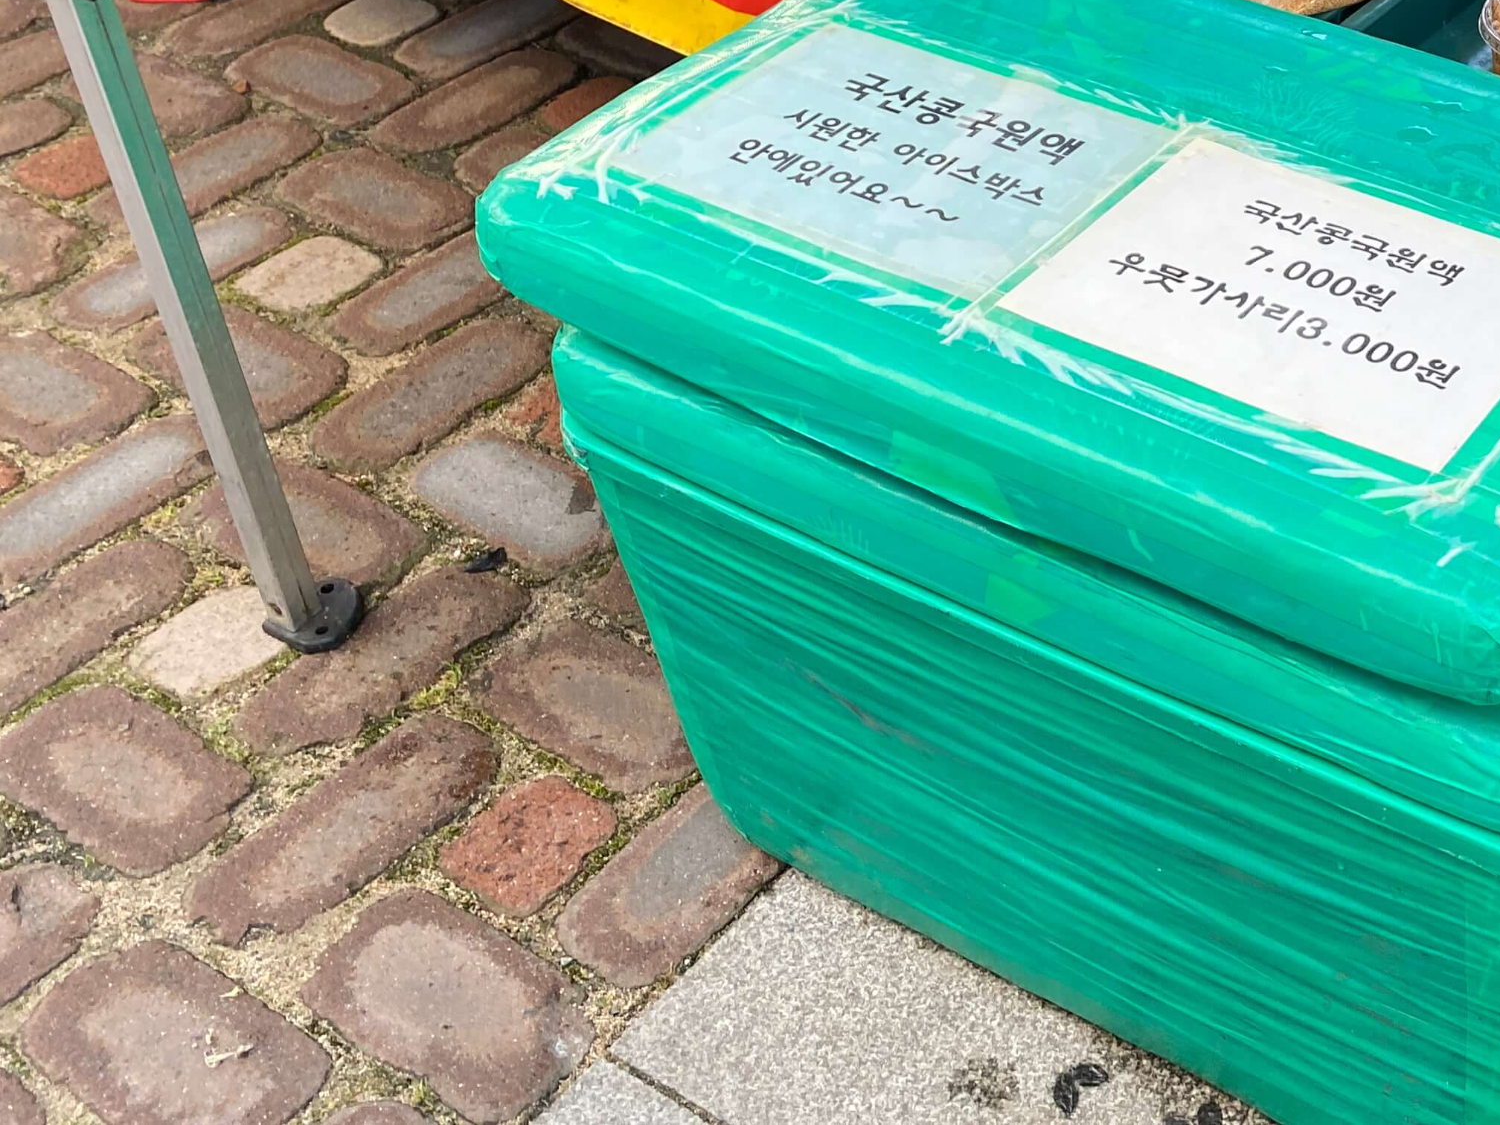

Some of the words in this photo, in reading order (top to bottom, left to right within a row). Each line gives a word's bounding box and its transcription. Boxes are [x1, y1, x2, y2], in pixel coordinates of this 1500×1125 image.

[783, 109, 881, 152] 시원한
[893, 143, 1047, 206] 아이스박스
[844, 73, 1085, 165] 국산콩국원액
[1244, 199, 1465, 287] 국산콩국원액
[1244, 245, 1397, 312] 7.000원
